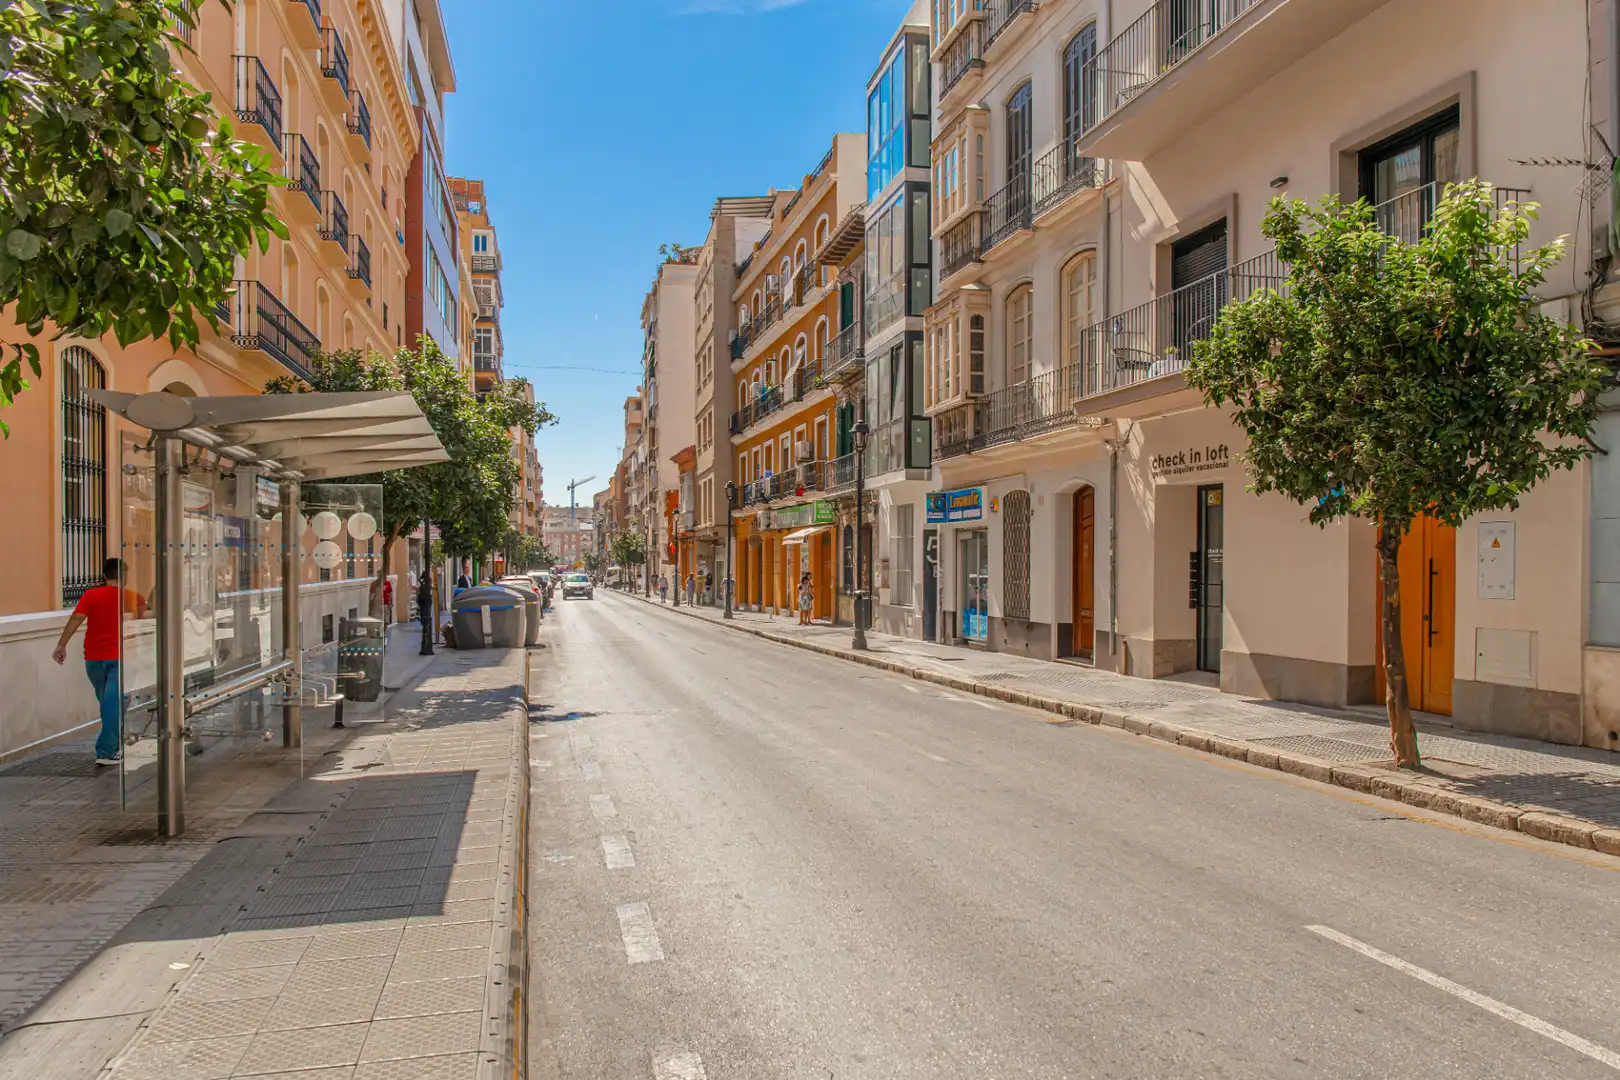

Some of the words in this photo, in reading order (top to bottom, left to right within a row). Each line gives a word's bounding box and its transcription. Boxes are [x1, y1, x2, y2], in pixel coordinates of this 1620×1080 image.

[1152, 451, 1186, 469] check
[1190, 447, 1201, 464] in
[1206, 444, 1229, 461] loft
[1196, 461, 1229, 471] vacacional
